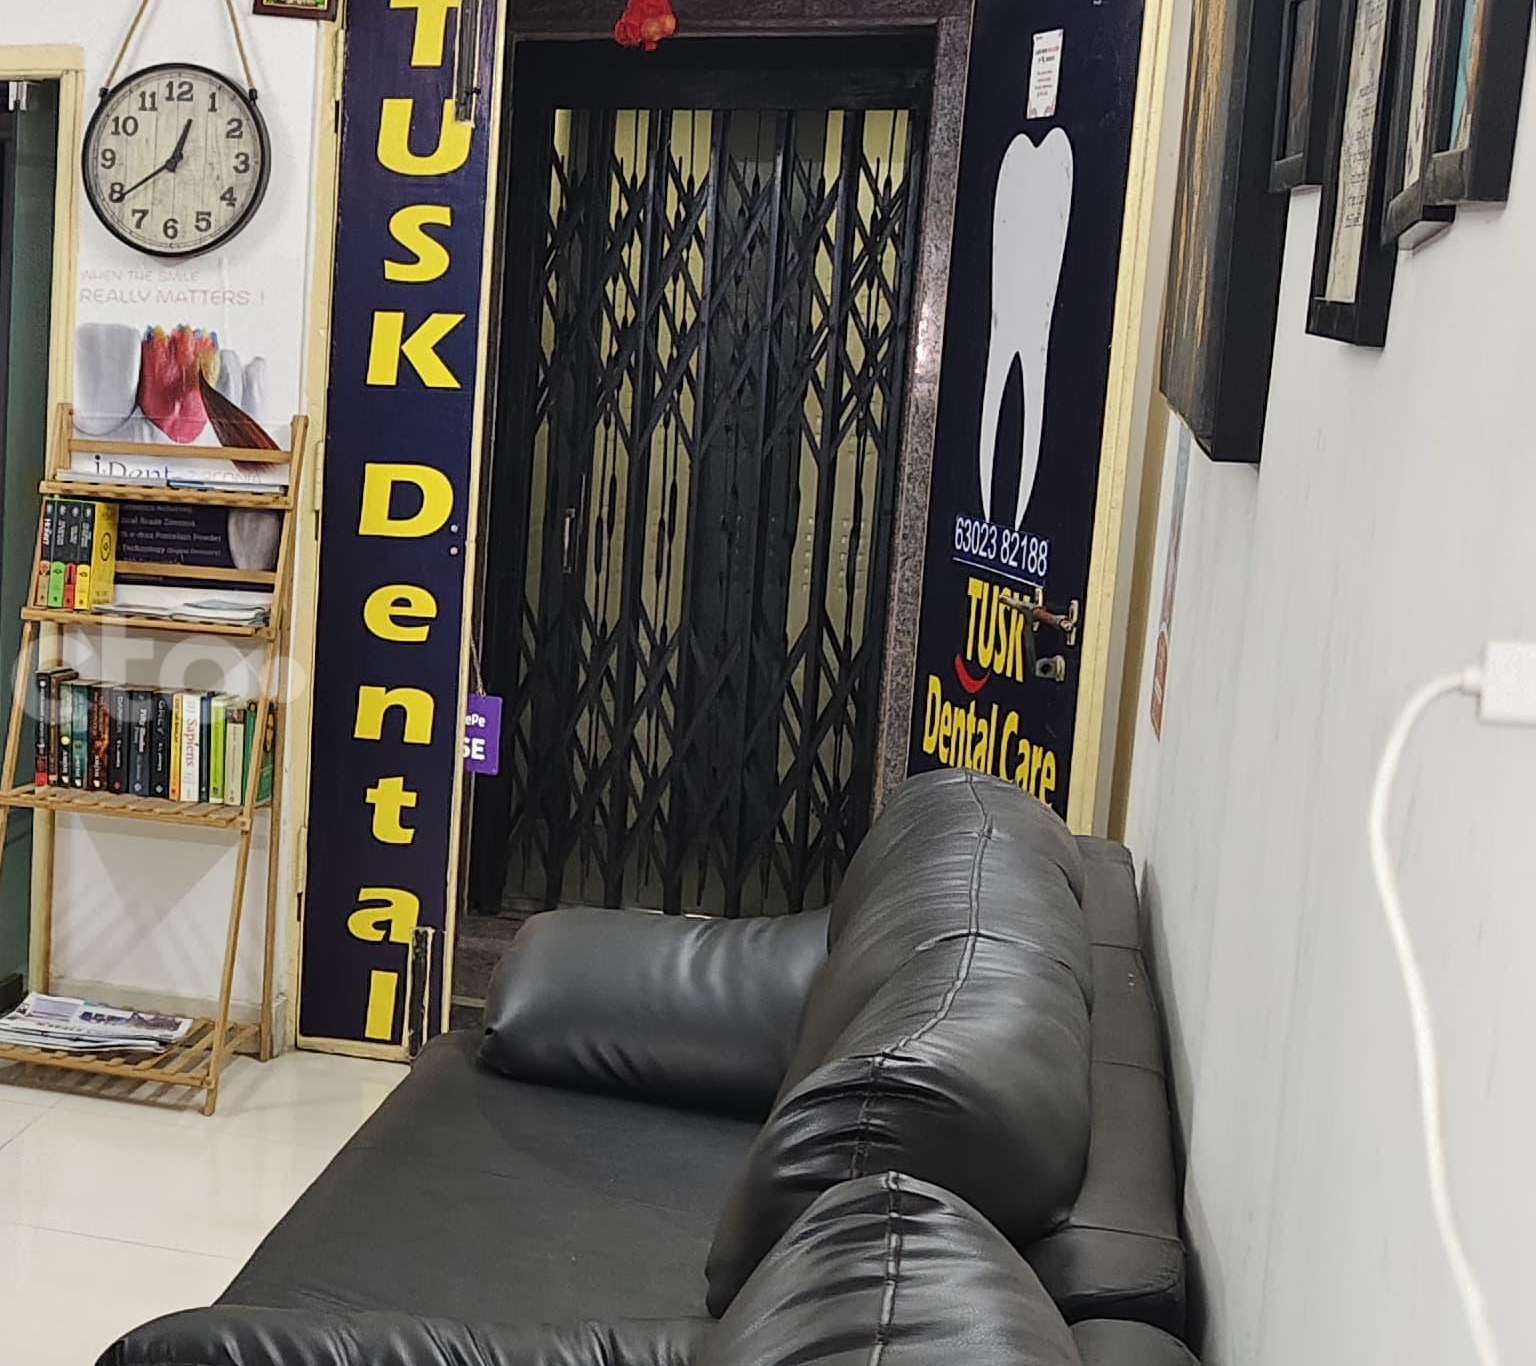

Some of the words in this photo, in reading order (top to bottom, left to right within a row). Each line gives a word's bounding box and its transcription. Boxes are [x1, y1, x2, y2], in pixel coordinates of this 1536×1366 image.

[138, 91, 158, 111] 11
[165, 81, 194, 102] 12
[208, 92, 218, 113] 1
[111, 116, 139, 136] 10
[226, 118, 243, 139] 2
[101, 148, 116, 170] 9
[233, 152, 250, 174] 3
[109, 182, 125, 203] 8
[220, 186, 237, 208] 4
[132, 209, 149, 229] 7
[162, 218, 178, 239] 6
[194, 211, 212, 232] 5
[127, 269, 153, 282] THE
[80, 288, 150, 304] REALLY
[955, 517, 997, 560] 63023
[1001, 529, 1048, 577] 82188
[967, 576, 1031, 683] TUSK
[185, 718, 199, 767] Sapiens
[347, 462, 456, 1041] Dental
[923, 674, 998, 776] Dental
[1000, 710, 1057, 808] Care
